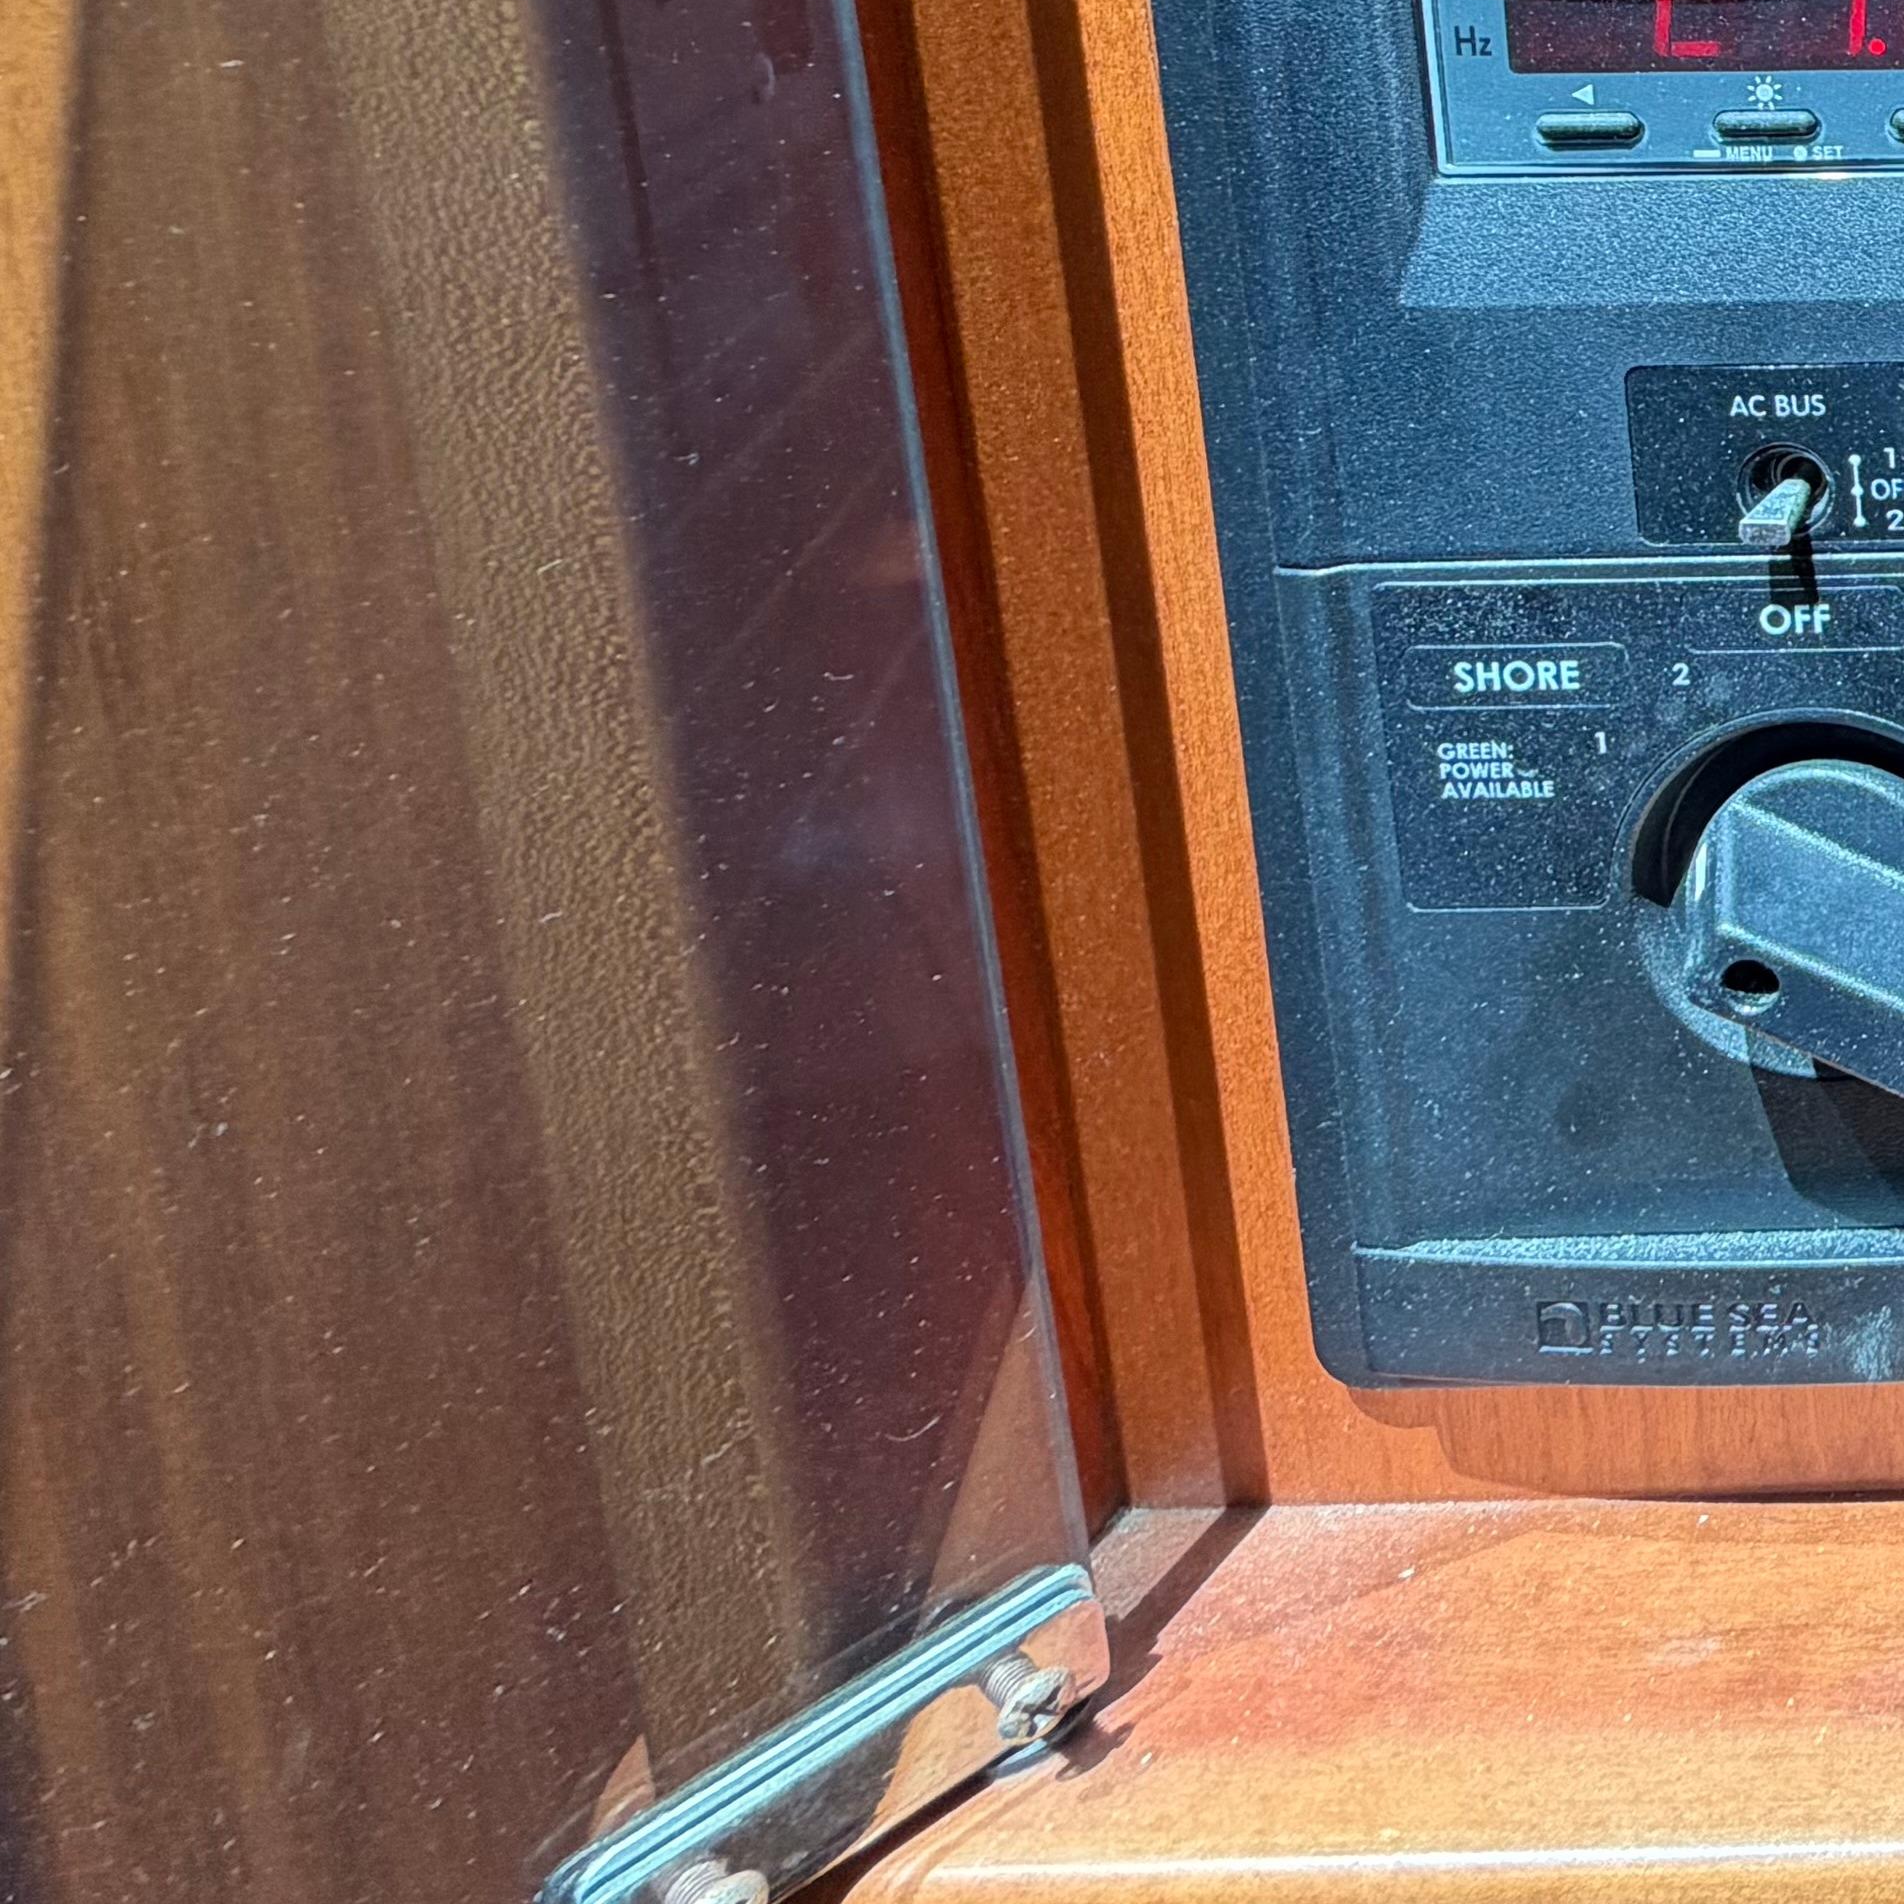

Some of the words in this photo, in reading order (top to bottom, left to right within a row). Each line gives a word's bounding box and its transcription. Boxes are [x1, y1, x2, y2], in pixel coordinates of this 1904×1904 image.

[1454, 25, 1493, 57] Hz
[1725, 147, 1774, 161] MENU
[1812, 146, 1844, 160] SET
[1729, 395, 1768, 418] AC
[1774, 394, 1827, 417] BUS
[1884, 448, 1897, 469] 1
[1886, 509, 1904, 532] 2
[1758, 604, 1832, 636] OFF
[1453, 660, 1581, 693] SHORE
[1672, 663, 1692, 686] 2
[1437, 742, 1514, 761] GREEN:
[1594, 731, 1607, 754] 1
[1439, 762, 1514, 780] POWER
[1441, 780, 1556, 800] AVAILABLE
[1599, 1301, 1716, 1332] BLUE
[1728, 1301, 1817, 1332] SEA
